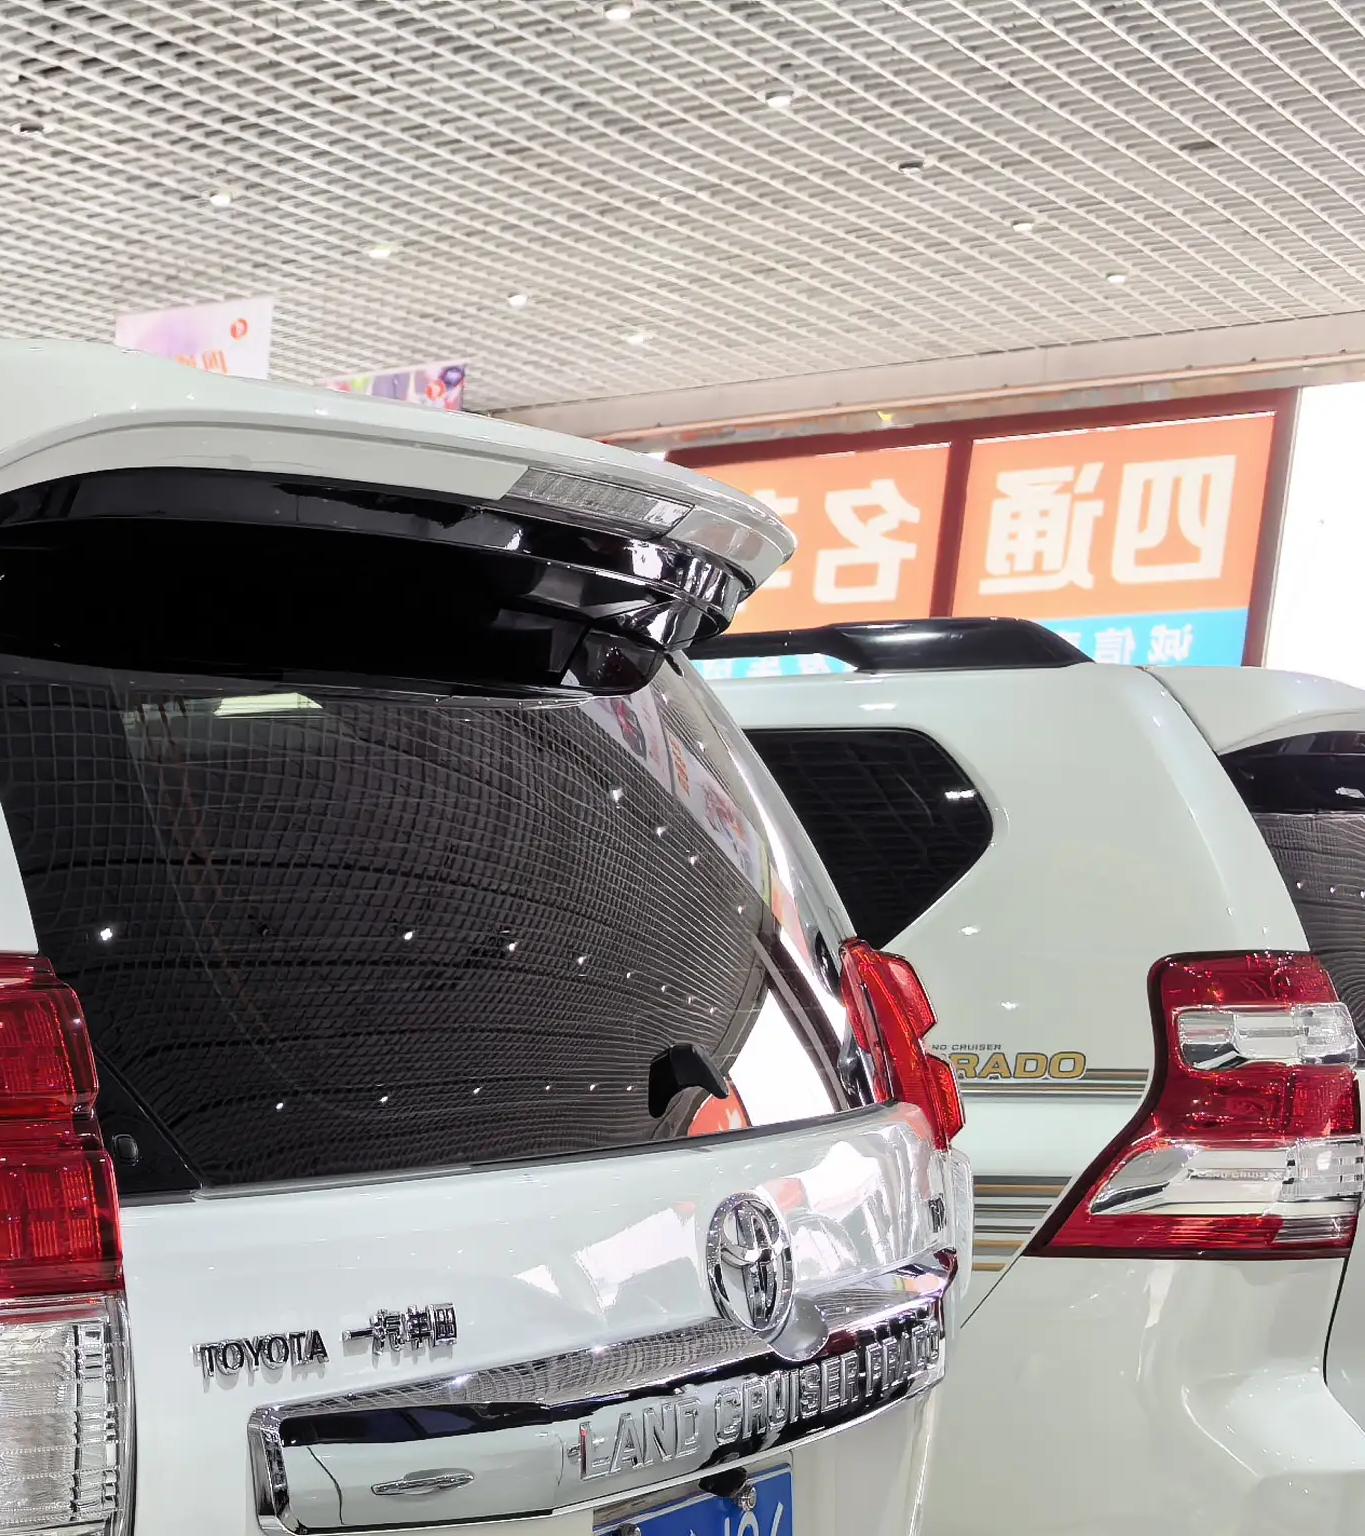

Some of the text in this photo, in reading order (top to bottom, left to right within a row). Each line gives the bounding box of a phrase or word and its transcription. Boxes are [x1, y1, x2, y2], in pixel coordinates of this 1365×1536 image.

[942, 1050, 1087, 1080] RADO
[951, 1043, 1002, 1051] CRUISER
[190, 1329, 329, 1377] TOYOTA
[340, 1302, 458, 1356] 一汽丰田
[579, 1319, 940, 1481] LAND CRUISER PRADO
